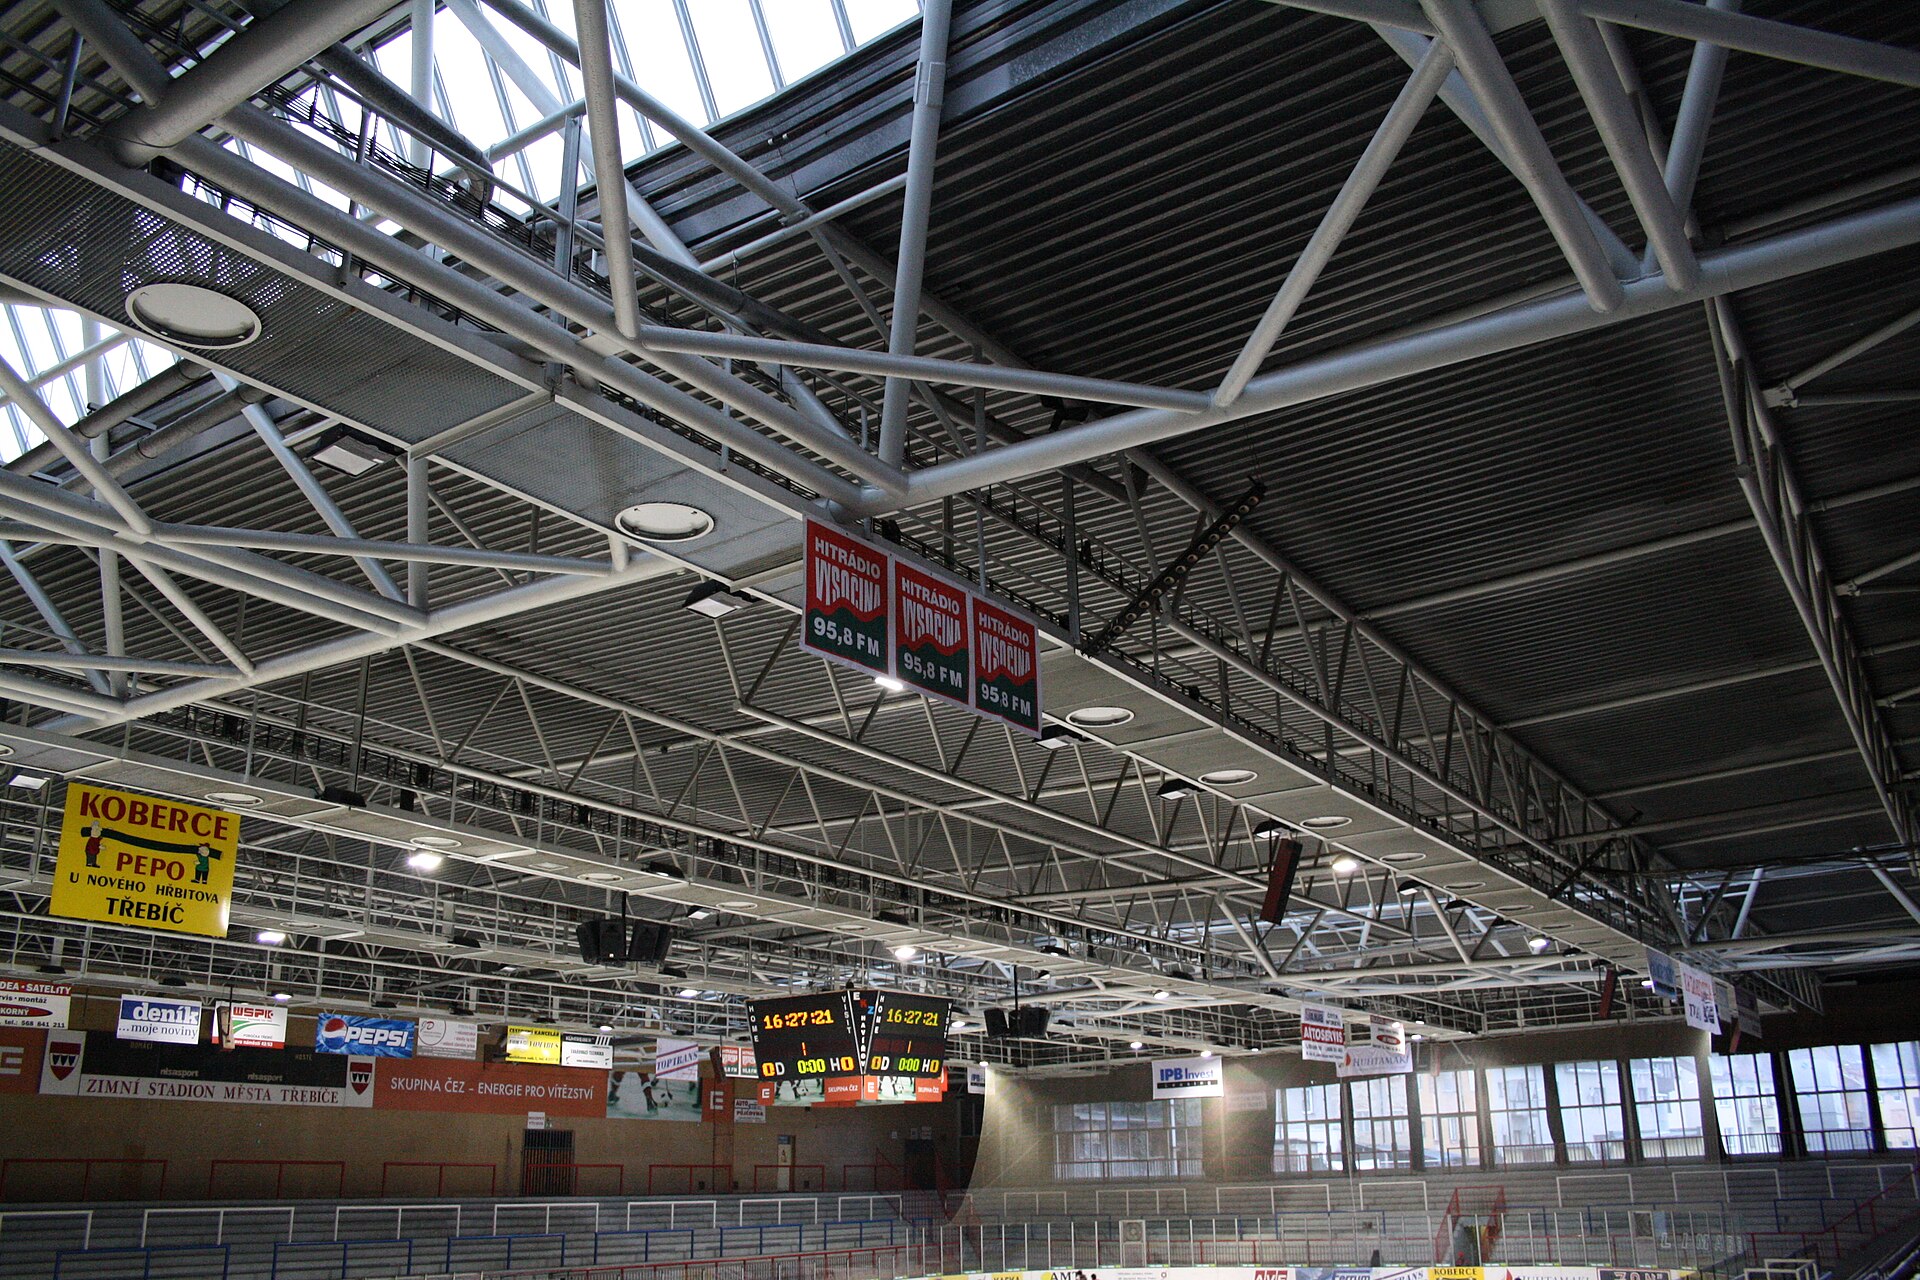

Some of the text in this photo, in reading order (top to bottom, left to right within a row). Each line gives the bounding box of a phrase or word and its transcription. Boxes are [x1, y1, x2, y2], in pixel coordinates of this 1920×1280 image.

[815, 537, 881, 580] HITRÁDIO
[815, 556, 881, 613] VYSOČINA
[901, 577, 960, 615] HITRÁDIO
[902, 596, 961, 648] VYSOČINA
[979, 611, 1030, 648] HITRÁDIO
[813, 616, 880, 658] 95,8 FM
[979, 630, 1031, 678] VYSOČINA
[904, 652, 963, 689] 95,8 FM
[1012, 696, 1031, 718] FM
[79, 791, 230, 841] KOBERCE
[115, 852, 186, 881] PEPO
[69, 872, 219, 904] U NOVÉHO HŘBITOVA
[105, 895, 185, 924] TŘEBÍČ
[18, 996, 48, 1004] montáž
[26, 983, 72, 995] SATELITY
[132, 1003, 200, 1025] deník
[748, 1005, 759, 1042] HOME
[764, 1009, 834, 1029] 16:27:21
[841, 996, 852, 1034] VISIT
[875, 995, 885, 1034] HOME
[887, 1008, 938, 1026] 16:27:21
[944, 1003, 952, 1039] VISIT
[161, 1026, 199, 1040] noviny
[344, 1026, 409, 1048] PEPSI
[1304, 1026, 1343, 1043] AUTOSERVIS
[657, 1051, 698, 1070] TOPTRANS
[797, 1058, 826, 1073] 0:00
[898, 1058, 920, 1072] 0:00
[1160, 1068, 1213, 1081] IPB Invest
[87, 1079, 339, 1103] ZIMNÍ STADION MĚSTA TŘEBÍČE
[391, 1077, 442, 1092] SKUPINA
[444, 1077, 465, 1093] ČEZ
[478, 1082, 522, 1096] ENERGIE
[525, 1085, 545, 1097] PRO
[548, 1083, 594, 1100] VÍTĚZSTVÍ
[1434, 1268, 1477, 1276] KOBERCE
